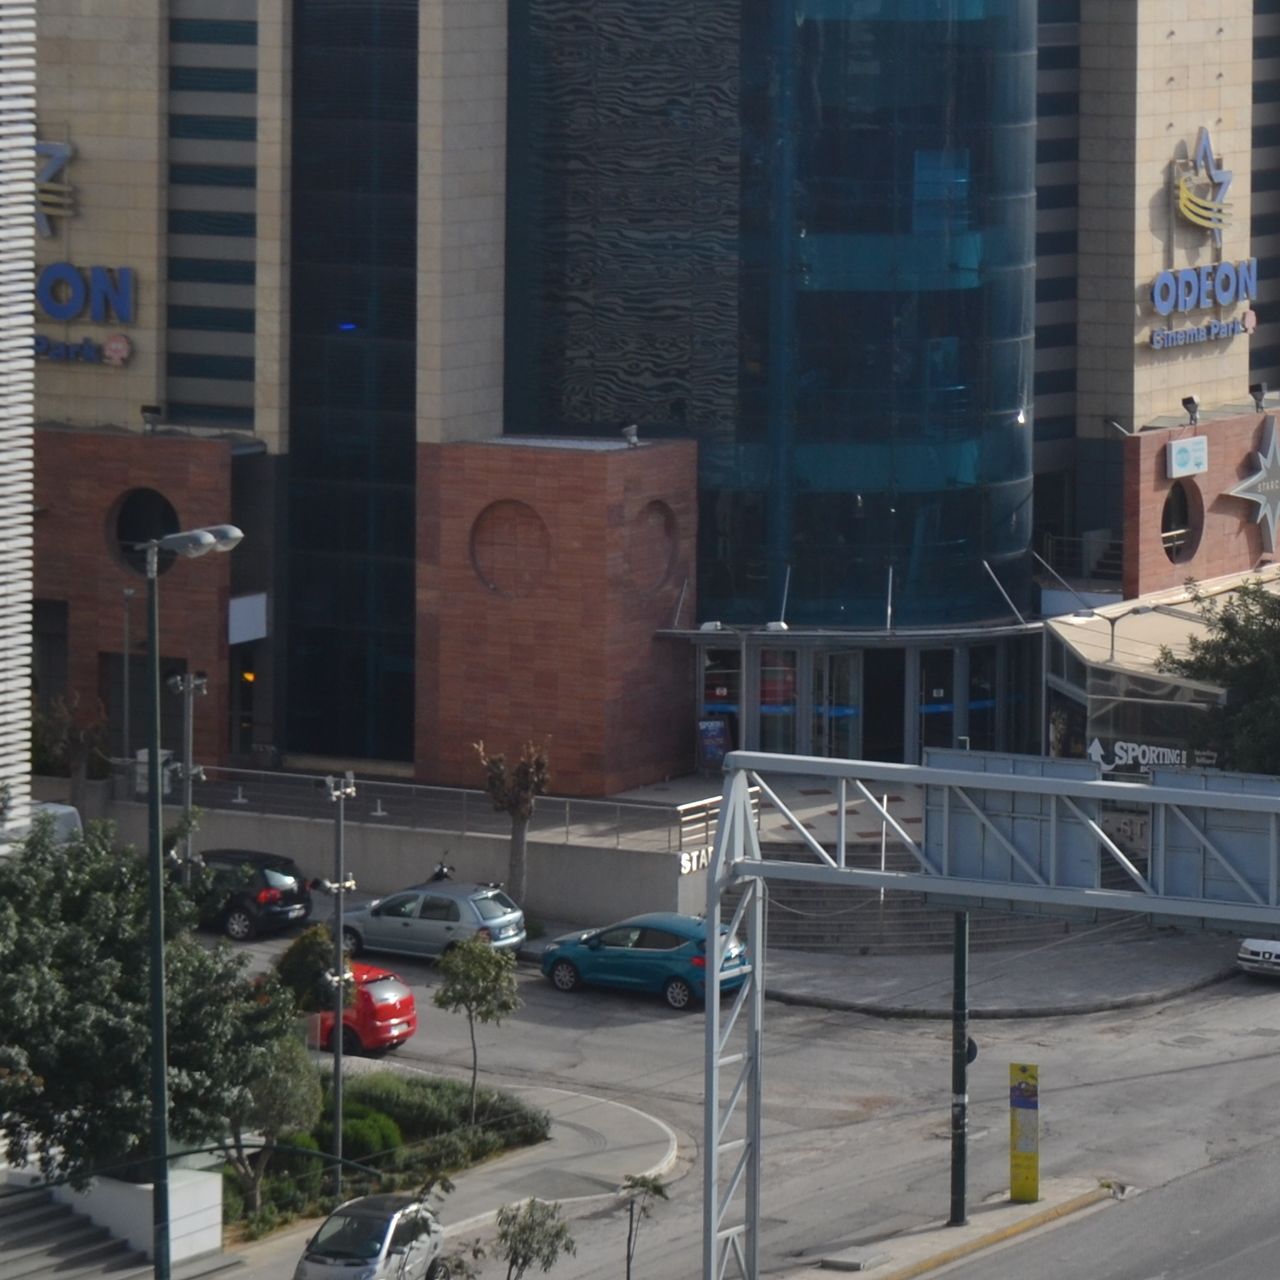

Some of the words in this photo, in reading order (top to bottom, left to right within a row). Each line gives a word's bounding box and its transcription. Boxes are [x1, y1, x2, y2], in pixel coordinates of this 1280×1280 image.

[1151, 257, 1257, 317] ODEON
[1151, 326, 1207, 350] Cinema
[1210, 319, 1244, 340] Park
[1114, 741, 1181, 765] SPORTING
